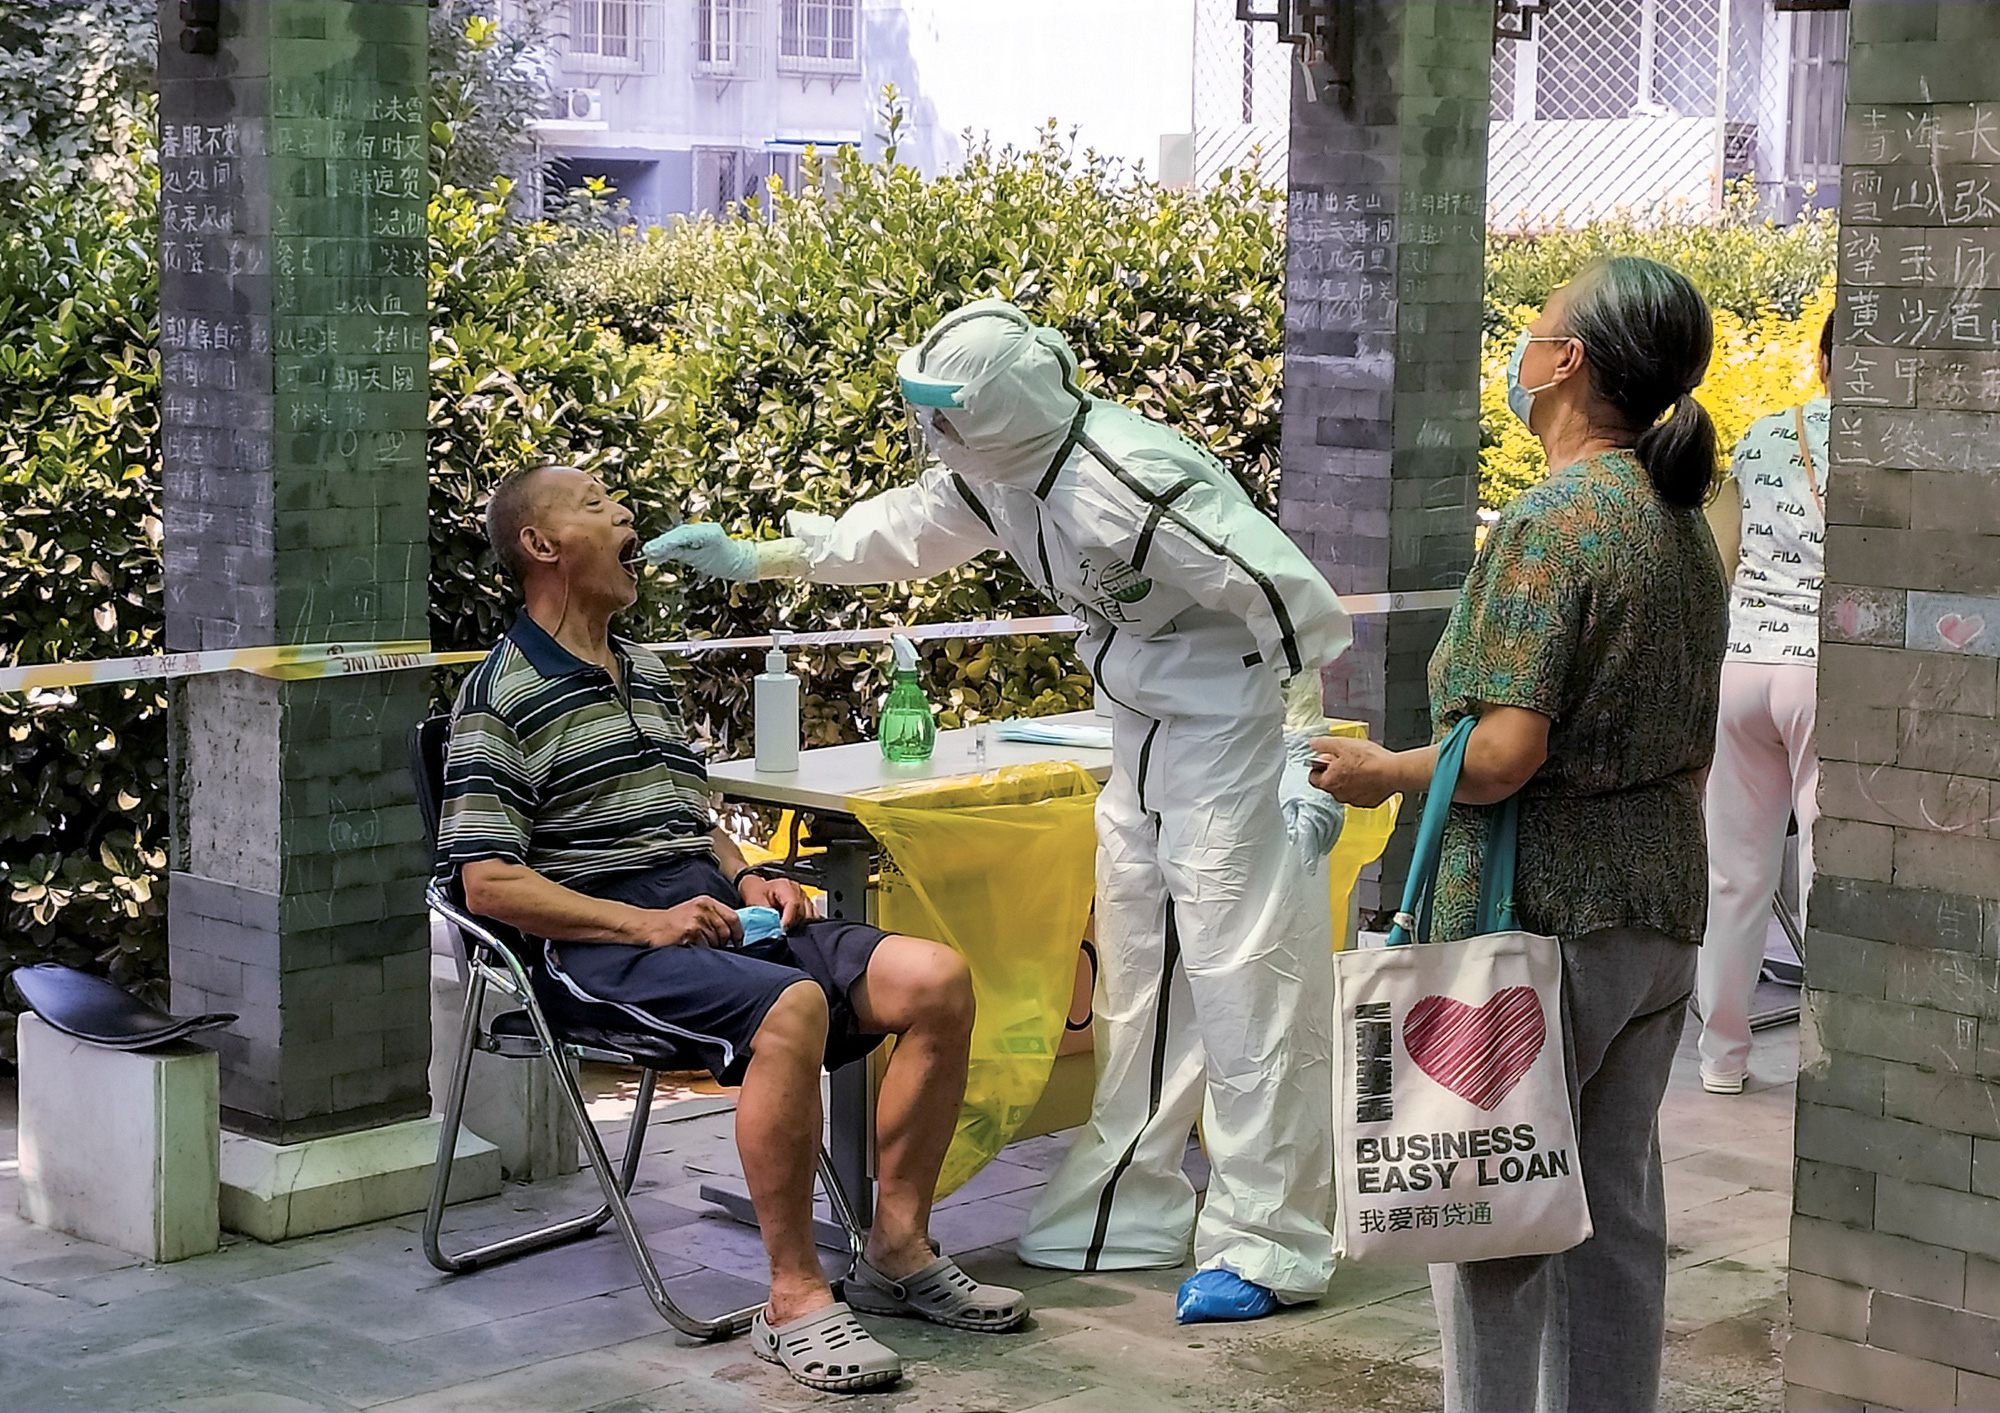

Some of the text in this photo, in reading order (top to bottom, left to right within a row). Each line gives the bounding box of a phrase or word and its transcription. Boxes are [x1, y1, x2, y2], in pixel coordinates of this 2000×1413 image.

[1769, 427, 1799, 441] FILA
[1755, 473, 1783, 488] FILA
[1776, 501, 1806, 517] FILA
[1747, 523, 1773, 536] FILA
[1771, 550, 1802, 564] FILA
[1740, 597, 1767, 608] FILA
[1758, 620, 1790, 633] FILA
[1726, 642, 1752, 654] FILA
[1782, 645, 1816, 658] FILA
[1354, 1001, 1394, 1124] I
[1356, 1124, 1536, 1165] BUSINESS
[1356, 1149, 1571, 1194] EASY LOAN
[1359, 1201, 1493, 1235] 我爱商贷通
